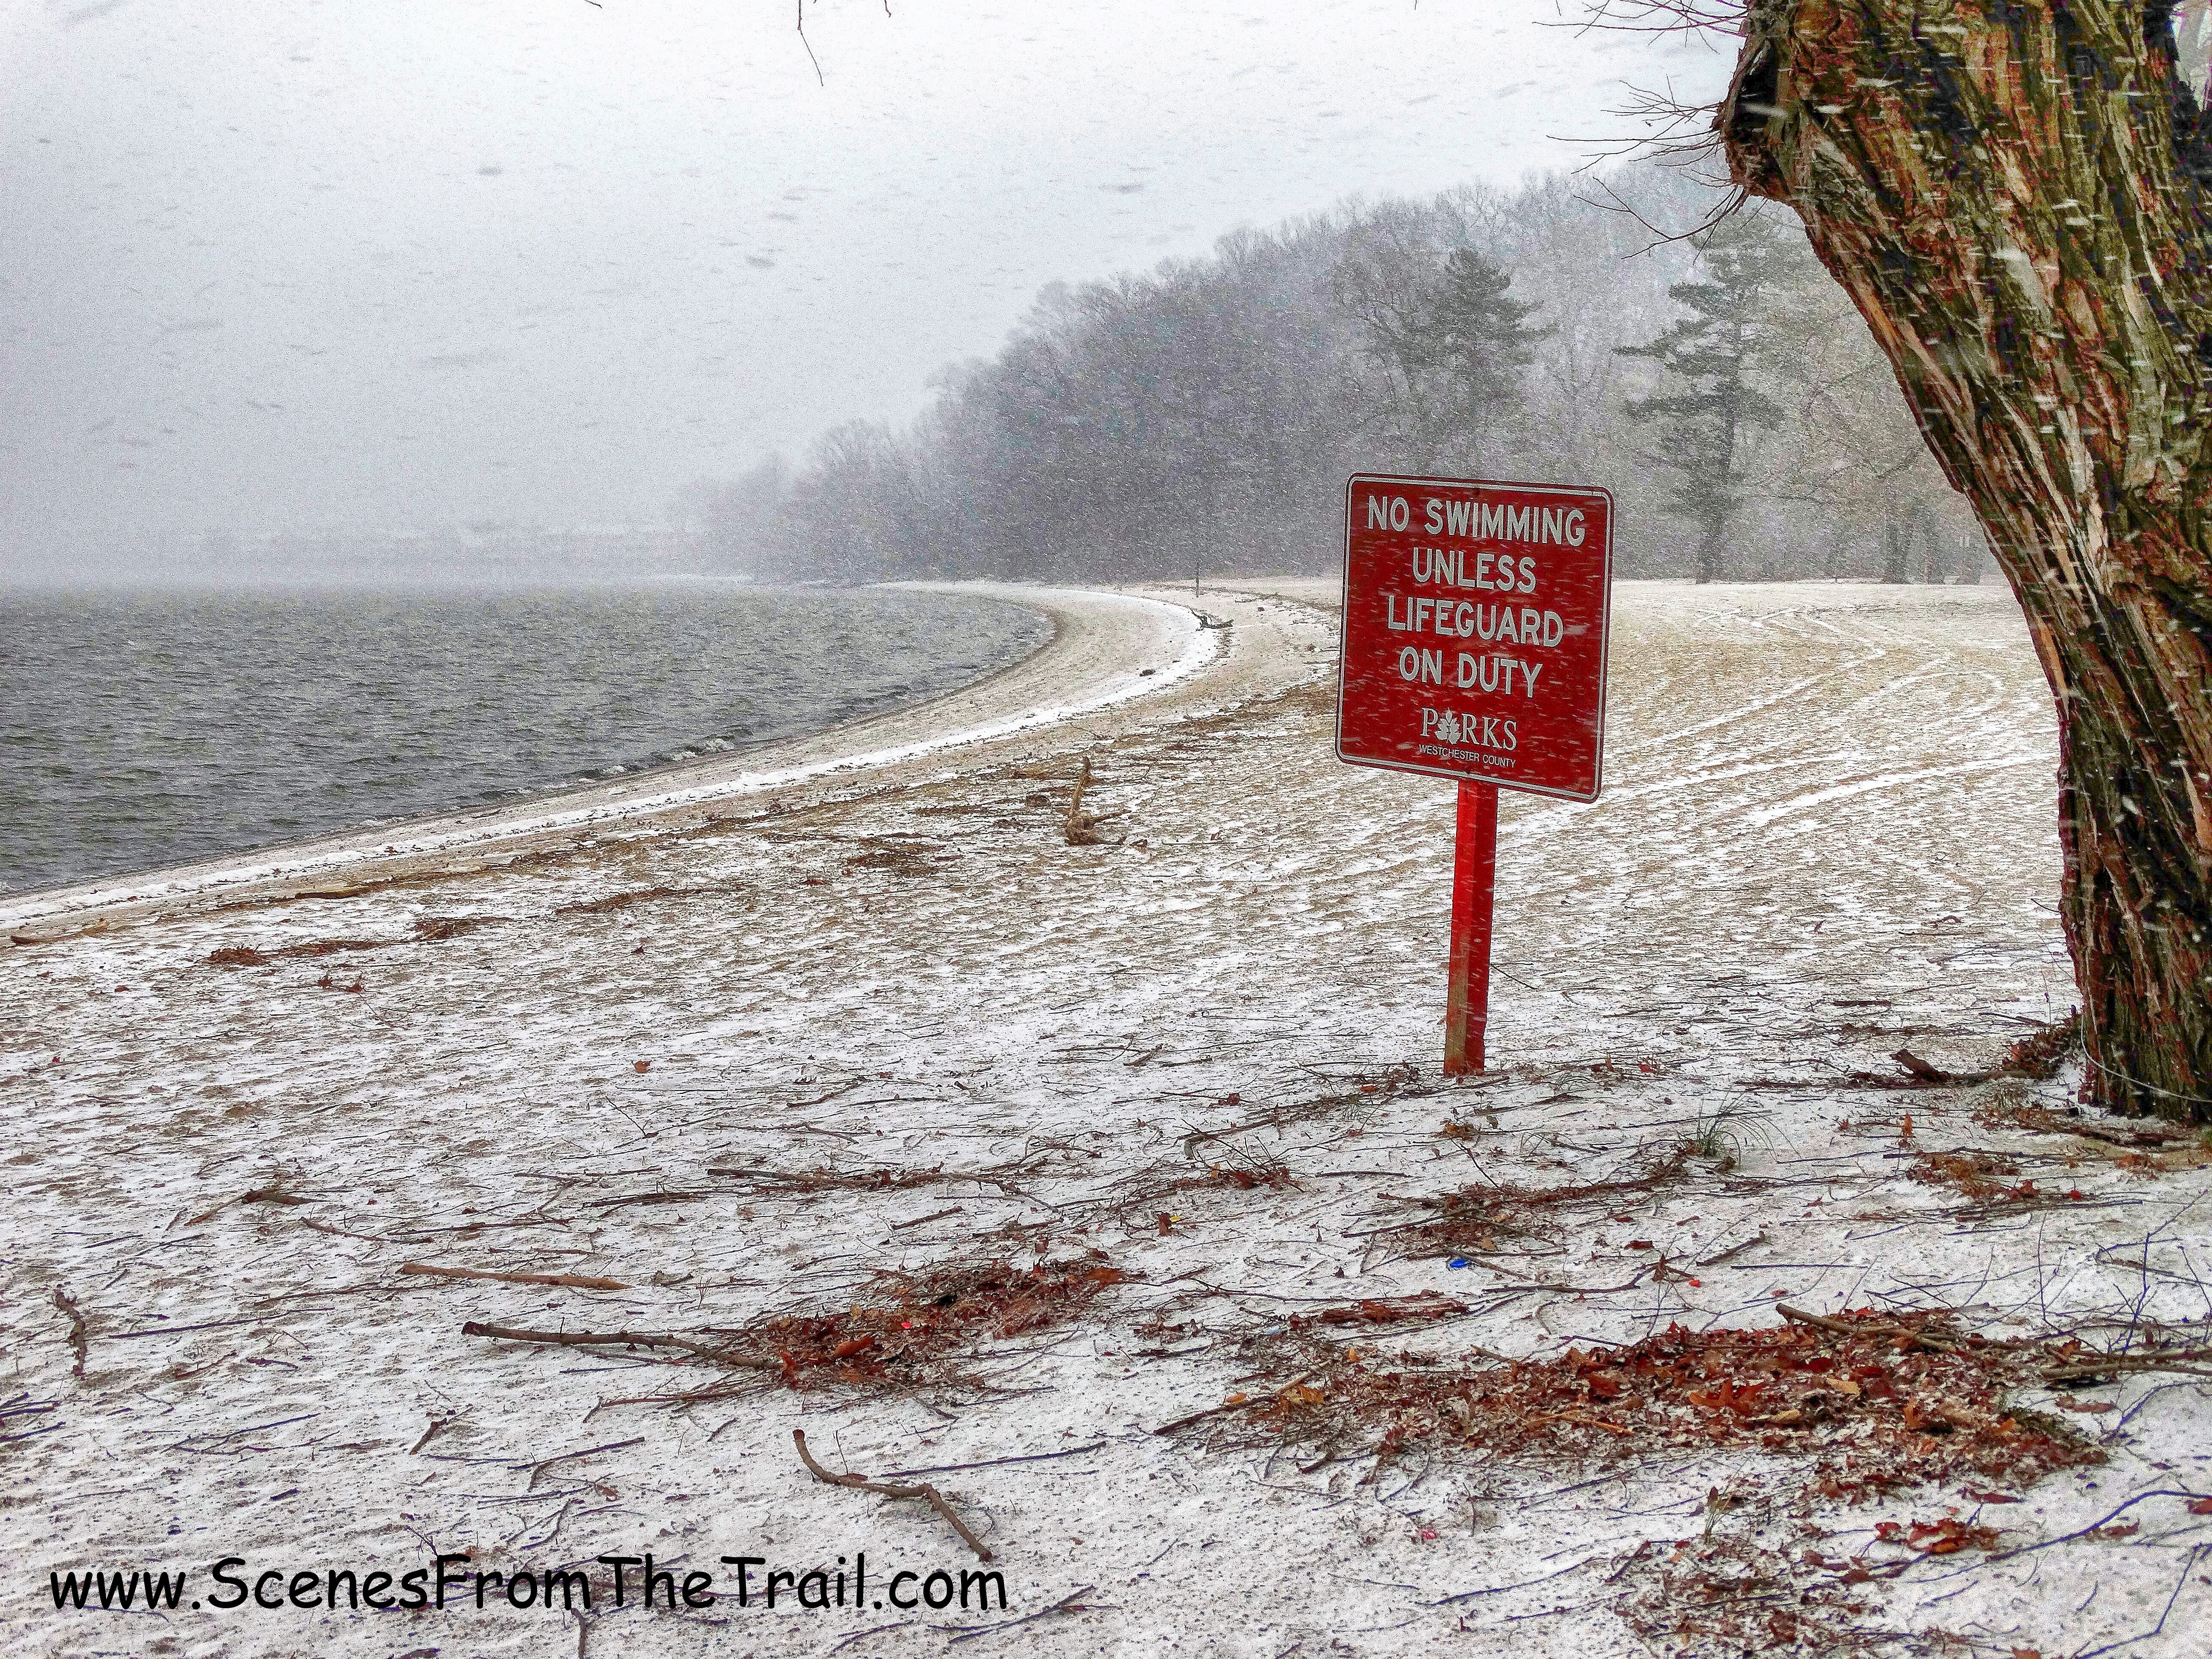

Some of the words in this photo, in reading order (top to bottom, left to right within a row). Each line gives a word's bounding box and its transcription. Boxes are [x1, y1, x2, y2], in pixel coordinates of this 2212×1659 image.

[1368, 495, 1410, 531] NO
[1424, 499, 1586, 546] SWIMMING
[1413, 547, 1537, 594] UNLESS
[1388, 595, 1563, 648] LIFEGUARD
[1399, 646, 1442, 684] ON
[1458, 653, 1543, 699] DUTY
[1420, 707, 1516, 751] PRKS
[1419, 744, 1480, 762] WESTCHESTER
[1483, 754, 1516, 768] COUNTY
